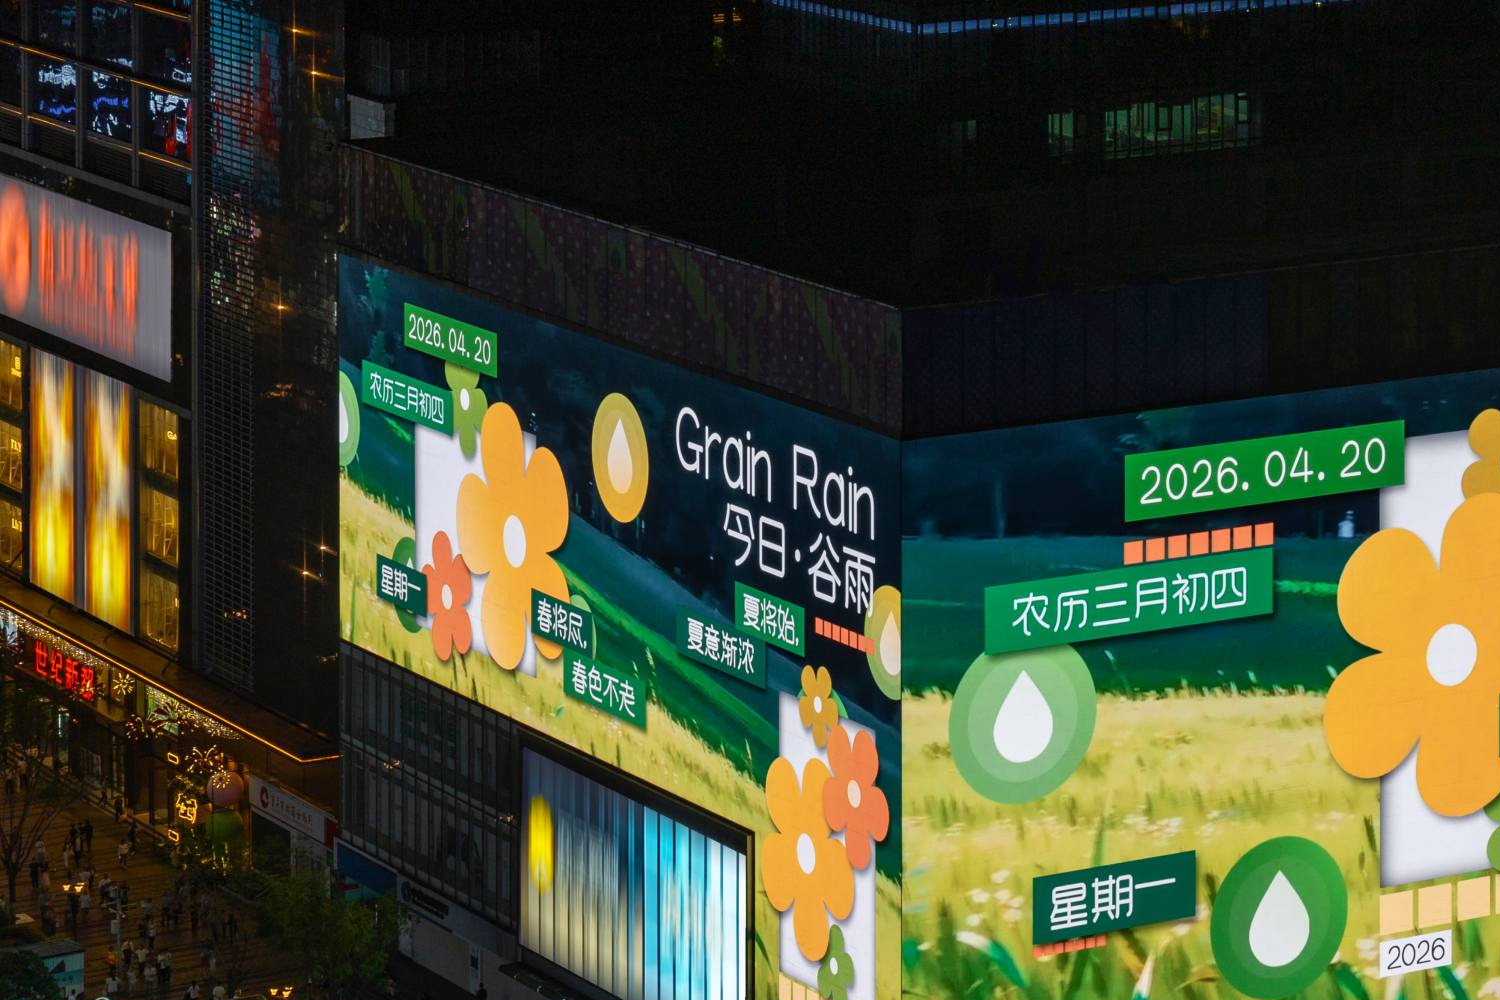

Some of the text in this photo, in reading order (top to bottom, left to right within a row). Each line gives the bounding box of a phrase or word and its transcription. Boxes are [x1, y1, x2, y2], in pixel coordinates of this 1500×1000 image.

[409, 314, 491, 366] 2026.04.20
[370, 373, 444, 425] 农历三月初四
[676, 407, 875, 541] Grain Rain
[1140, 438, 1386, 505] 2026.04.20
[381, 564, 422, 602] 星期一
[723, 503, 876, 615] 今日·谷雨
[1012, 566, 1247, 636] 农历三月初四
[687, 617, 756, 675] 夏意渐浓
[571, 659, 637, 719] 春色不老
[1049, 873, 1177, 932] 星期一
[1387, 936, 1445, 971] 2026
